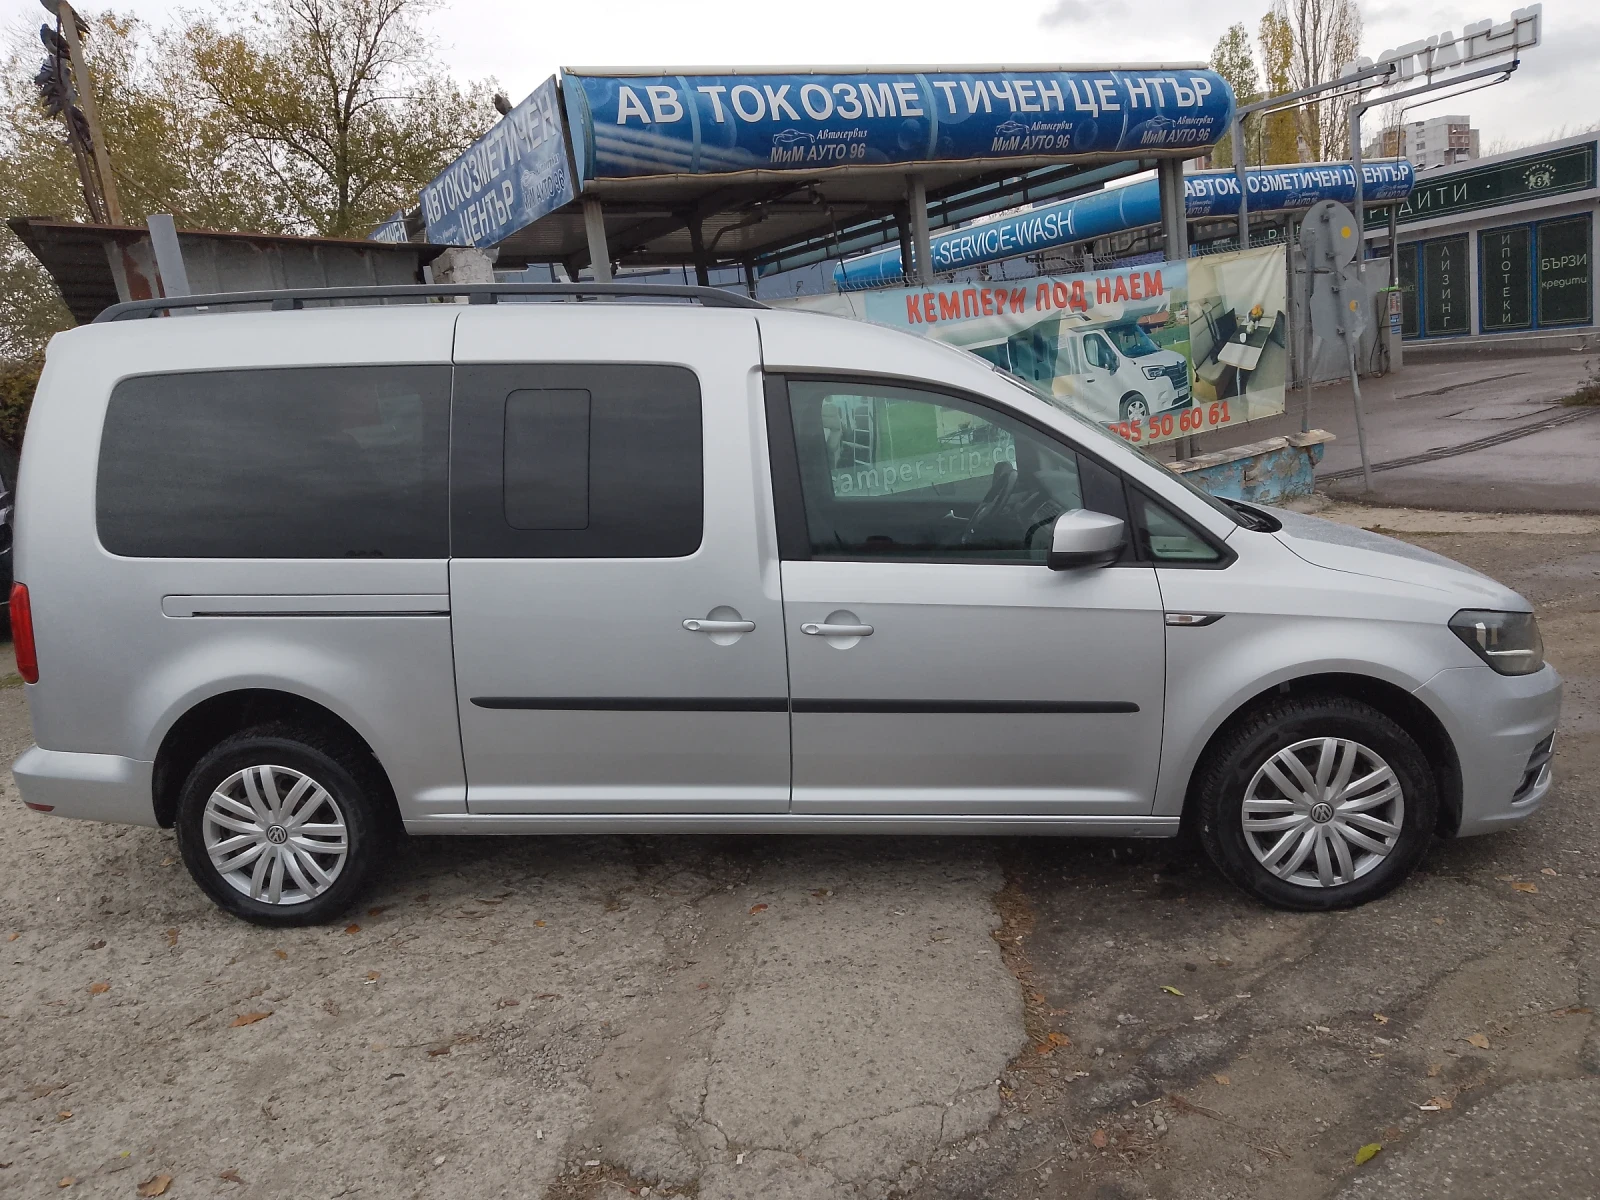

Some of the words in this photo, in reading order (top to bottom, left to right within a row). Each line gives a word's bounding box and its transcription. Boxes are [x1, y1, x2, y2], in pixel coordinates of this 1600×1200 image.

[816, 127, 868, 141] Автосервиз
[1030, 120, 1073, 132] Автосервиз
[1140, 129, 1168, 145] МиМ
[1166, 128, 1197, 143] АУТО
[1196, 127, 1211, 141] 96
[770, 145, 805, 163] МиМ
[806, 143, 847, 161] АУТО
[849, 142, 867, 159] 96
[991, 135, 1021, 152] МиМ
[1020, 134, 1055, 151] АУТО
[1055, 133, 1071, 149] 96
[424, 91, 557, 227] АВТОКОЗМЕТИЧЕН
[459, 179, 515, 248] ЦЕНТЪР
[1541, 253, 1587, 271] БЪРЗИ
[1441, 246, 1451, 328] ЛИЗИНГ
[1501, 234, 1512, 324] ИПОТЕКИ
[1541, 277, 1587, 290] кредити
[906, 286, 1028, 325] КЕМПЕРИ
[1036, 279, 1089, 313] ПОД
[1095, 269, 1164, 305] НАЕМ
[1149, 413, 1174, 438] 50
[1179, 406, 1203, 431] 60
[1208, 400, 1231, 425] 61
